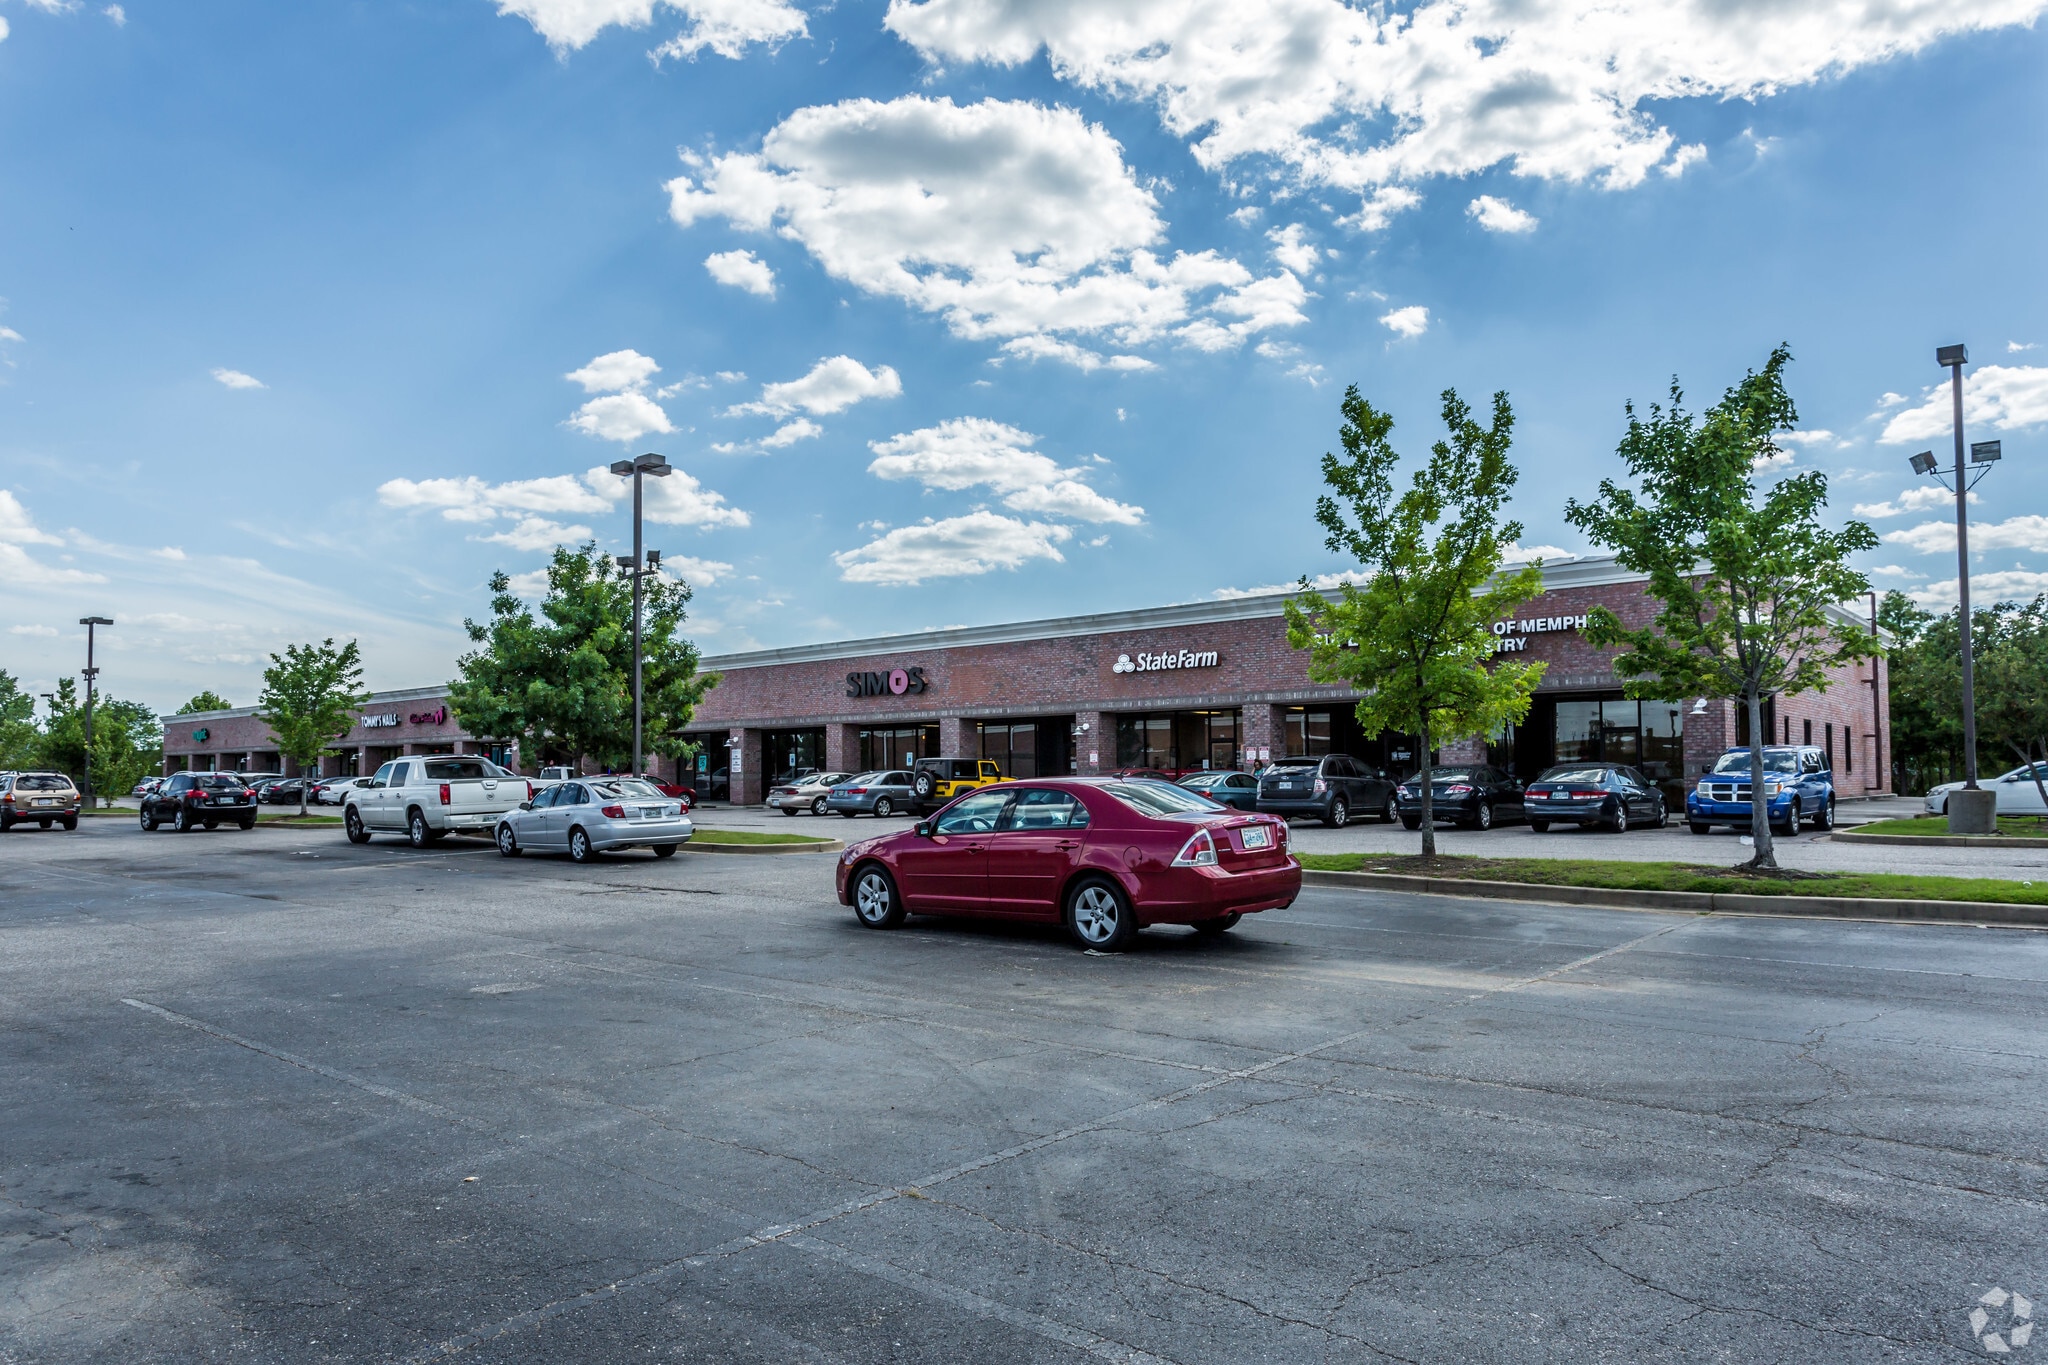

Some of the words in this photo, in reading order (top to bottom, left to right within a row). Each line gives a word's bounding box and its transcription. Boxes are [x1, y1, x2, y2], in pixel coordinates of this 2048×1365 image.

[1493, 621, 1516, 635] OF
[1521, 614, 1603, 633] MEMPH
[846, 667, 924, 698] SIMOS
[361, 715, 382, 728] TOMMY'S
[382, 713, 397, 726] NAILS
